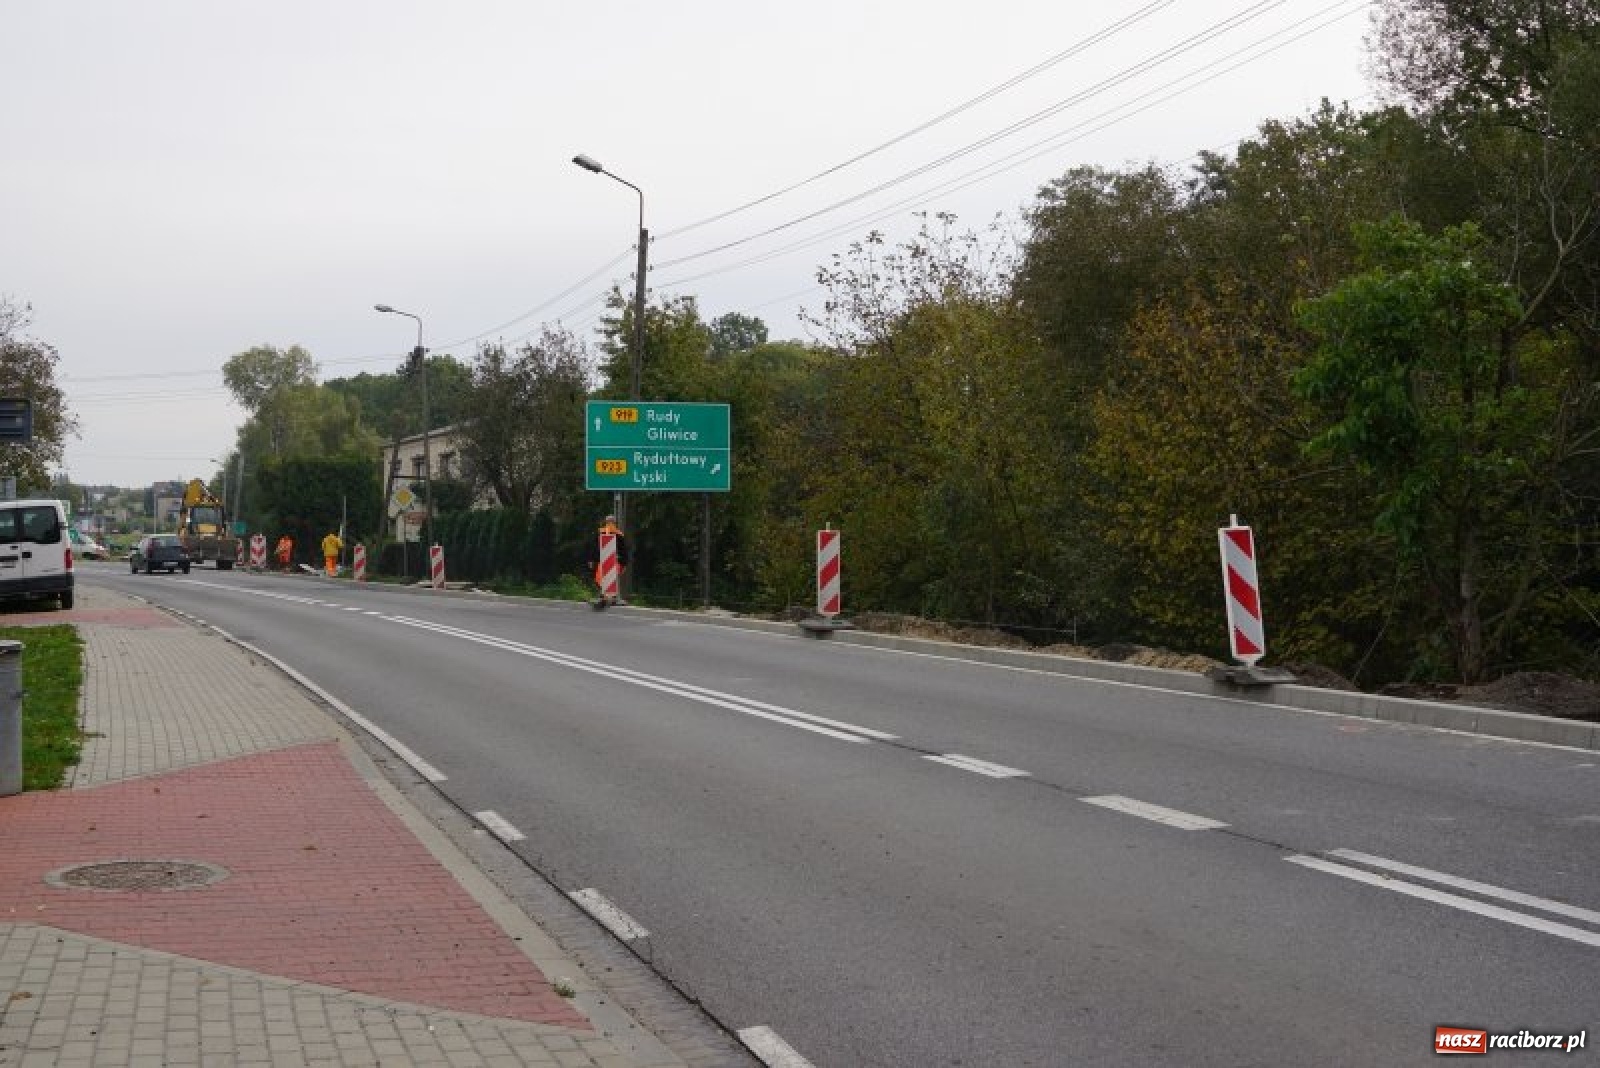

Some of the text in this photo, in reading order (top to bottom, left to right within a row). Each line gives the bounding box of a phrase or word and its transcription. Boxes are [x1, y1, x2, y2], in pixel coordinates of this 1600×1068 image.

[615, 409, 633, 419] 919
[646, 409, 681, 425] Rudy
[647, 427, 699, 441] Gliwice
[633, 469, 667, 486] Lyski
